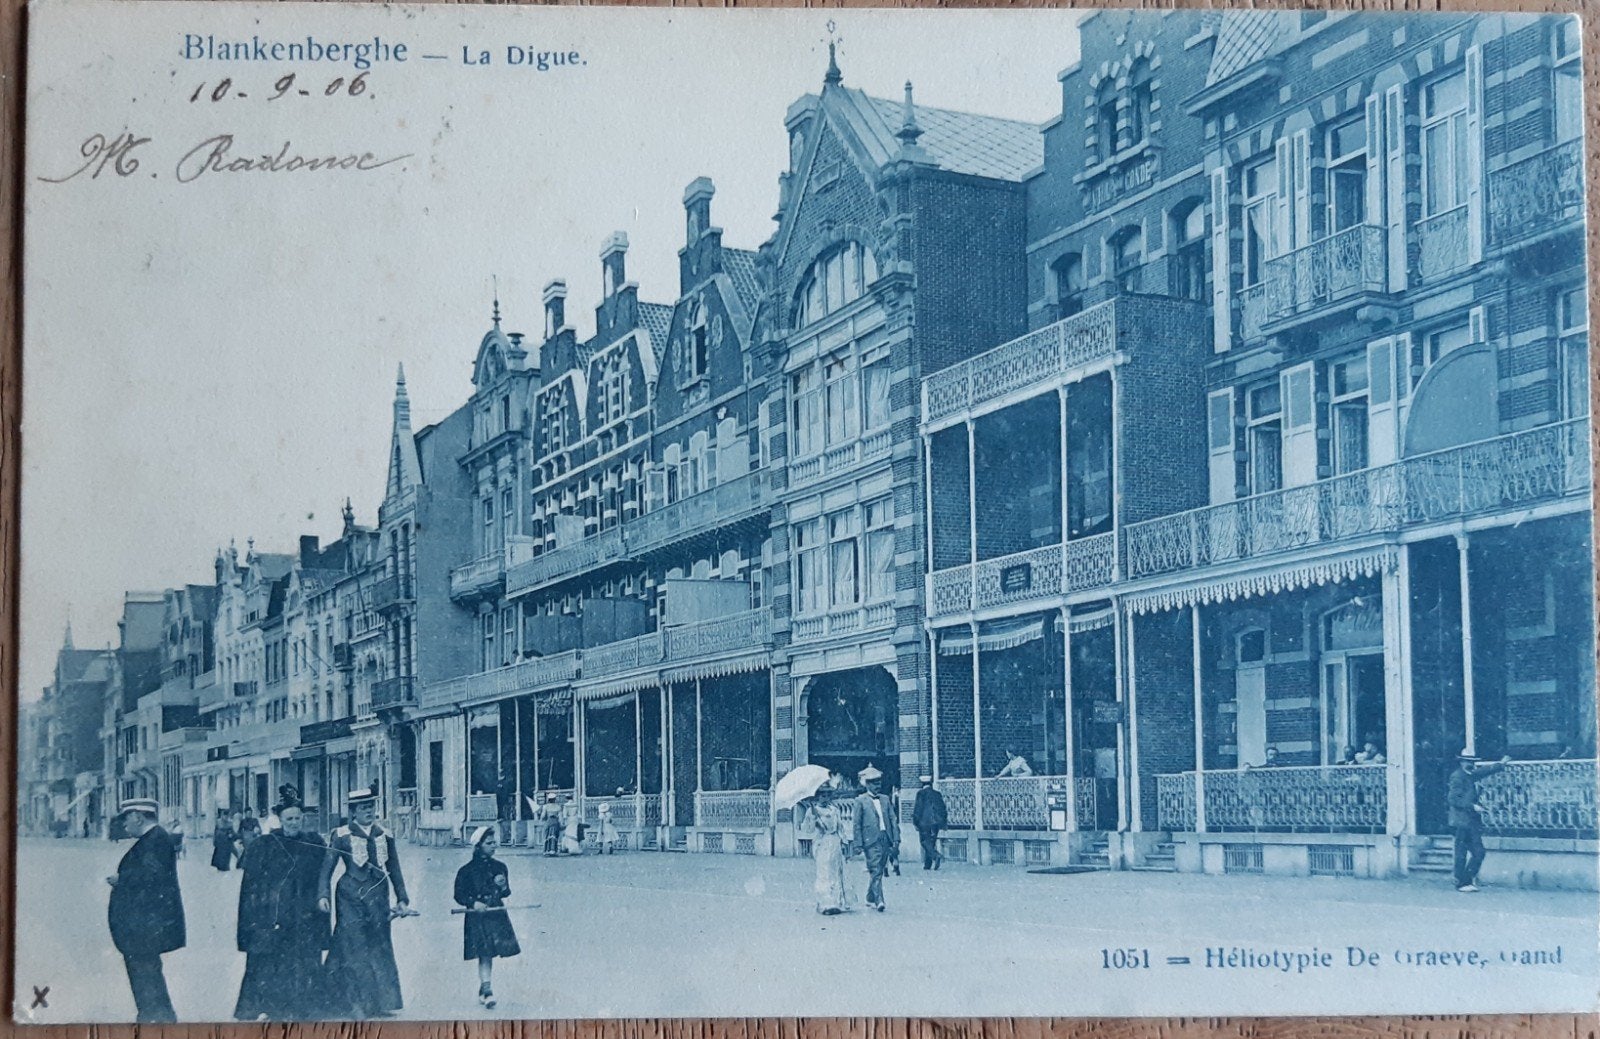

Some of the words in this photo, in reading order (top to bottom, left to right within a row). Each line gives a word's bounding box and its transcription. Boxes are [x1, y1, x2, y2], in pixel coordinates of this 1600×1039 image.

[184, 34, 408, 69] Blankenberghe
[463, 46, 490, 65] La
[507, 46, 587, 72] Digue.
[1101, 949, 1150, 970] 1051
[1206, 947, 1333, 973] Héliotypie
[1346, 947, 1381, 968] De
